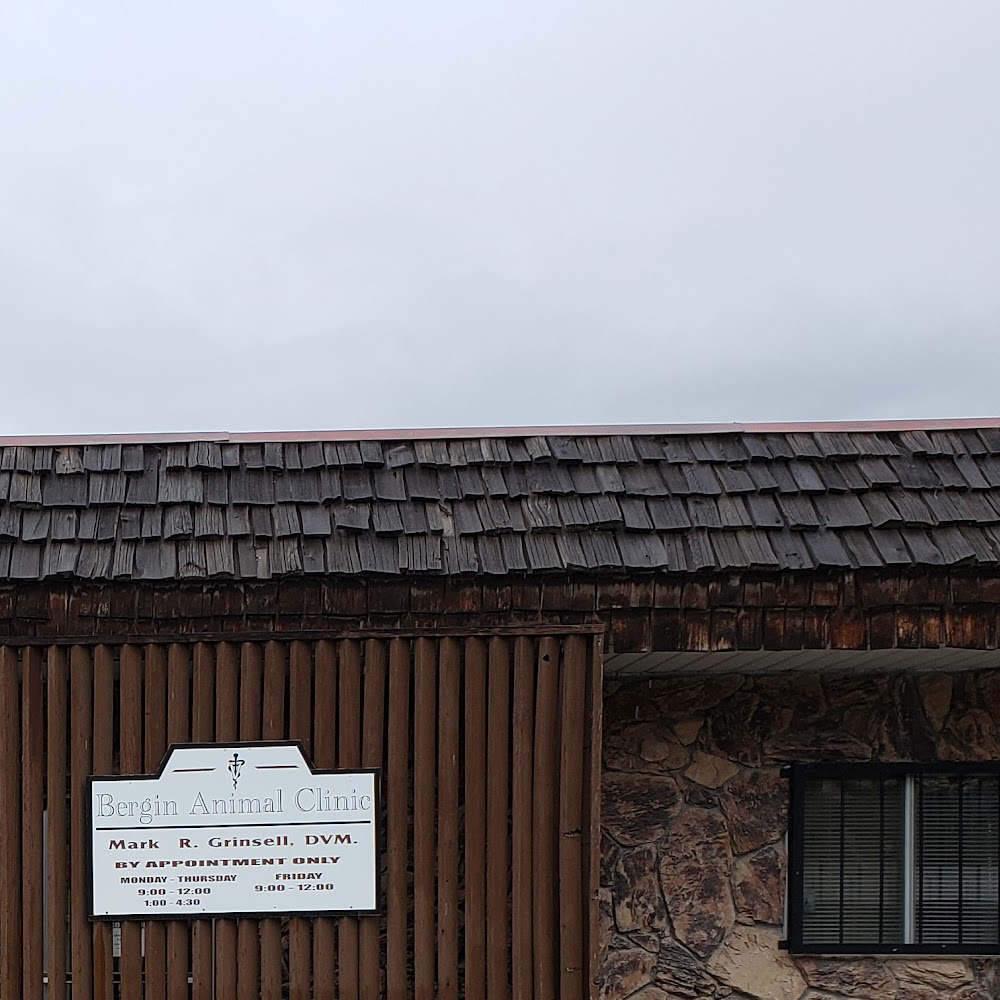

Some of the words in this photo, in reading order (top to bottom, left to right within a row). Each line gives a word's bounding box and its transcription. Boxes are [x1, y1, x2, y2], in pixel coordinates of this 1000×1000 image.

[96, 793, 178, 825] Bergin
[189, 789, 284, 816] Animal
[294, 787, 371, 812] Clinic
[108, 839, 160, 850] Mark
[179, 838, 198, 849] R.
[208, 836, 294, 848] Grinsell,
[305, 834, 358, 846] DVM.
[115, 861, 141, 869] BY
[145, 858, 288, 868] APPOINTMENT
[292, 856, 341, 865] ONLY
[120, 876, 168, 884] MONDAY
[177, 874, 237, 883] THURSDAY
[275, 872, 323, 880] FRIDAY
[137, 888, 166, 896] 9:00
[177, 887, 211, 895] 12:00
[254, 884, 285, 892] 9:00
[297, 883, 334, 891] 12:00
[143, 899, 167, 907] 1:00
[175, 898, 200, 906] 4:30
